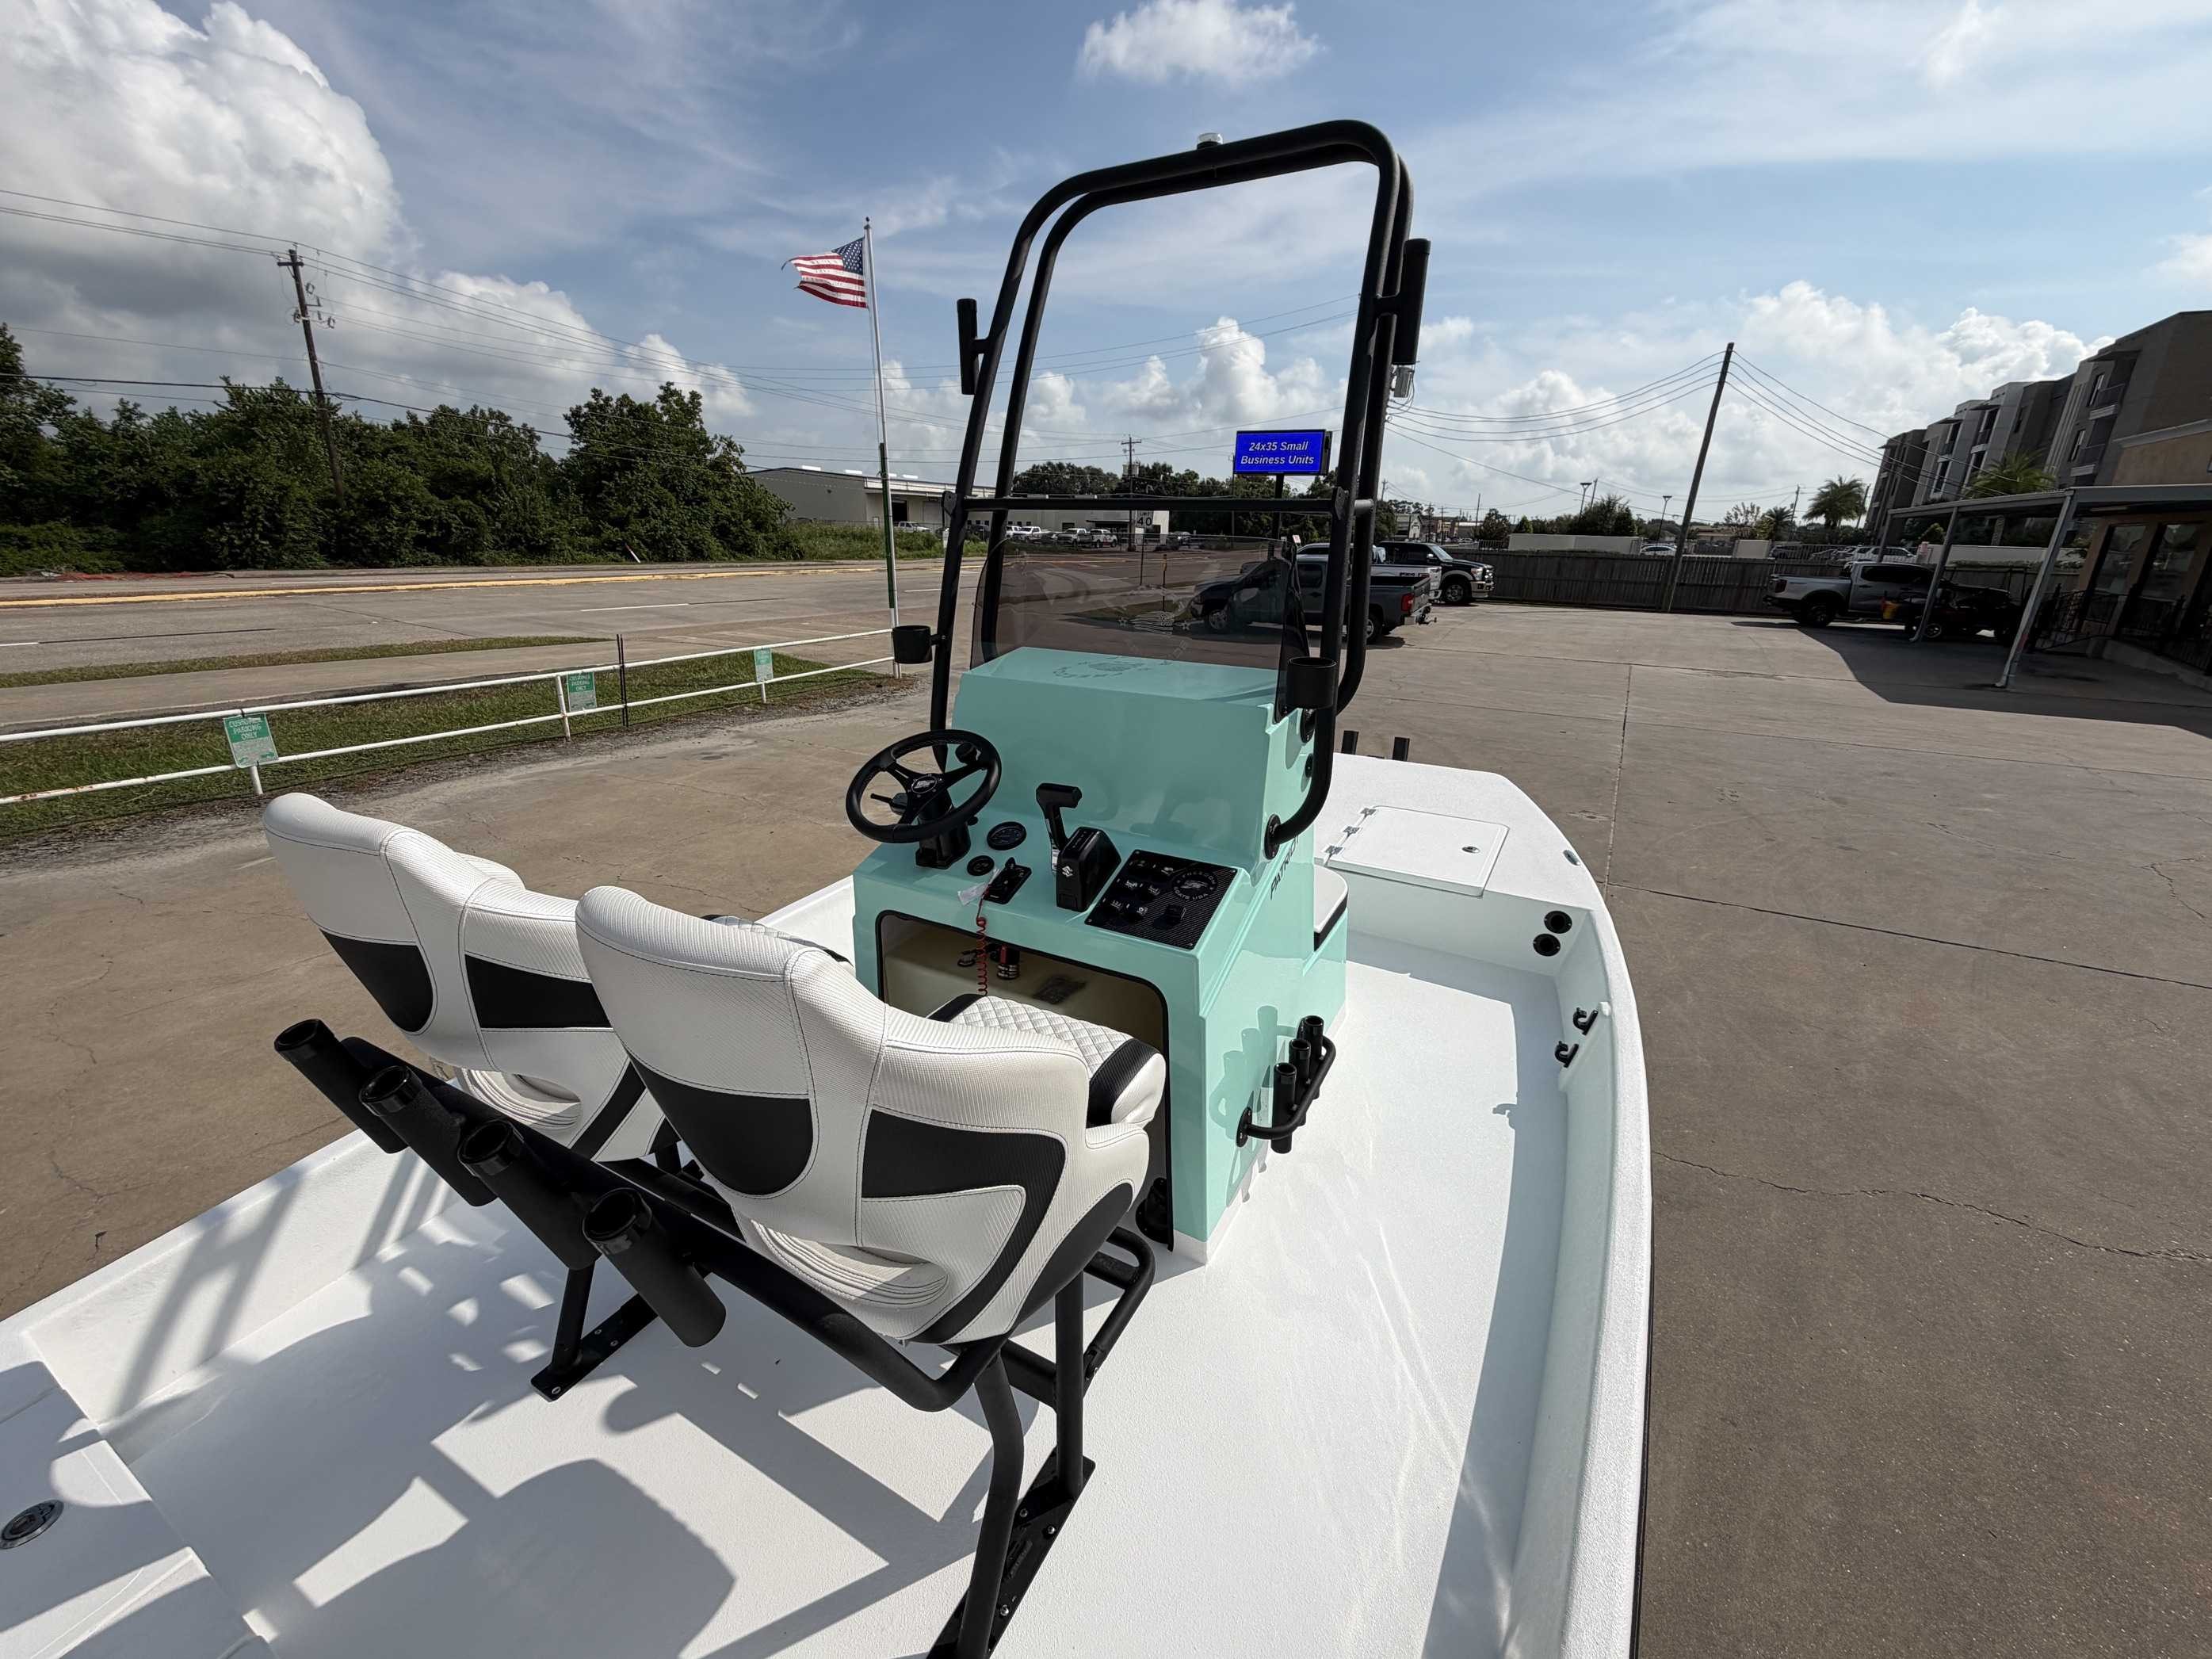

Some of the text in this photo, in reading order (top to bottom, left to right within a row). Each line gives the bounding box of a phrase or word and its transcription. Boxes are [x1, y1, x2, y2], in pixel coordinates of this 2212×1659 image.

[1248, 441, 1308, 452] 24x35 Small
[1240, 454, 1314, 464] Business Units
[1137, 517, 1152, 526] 40
